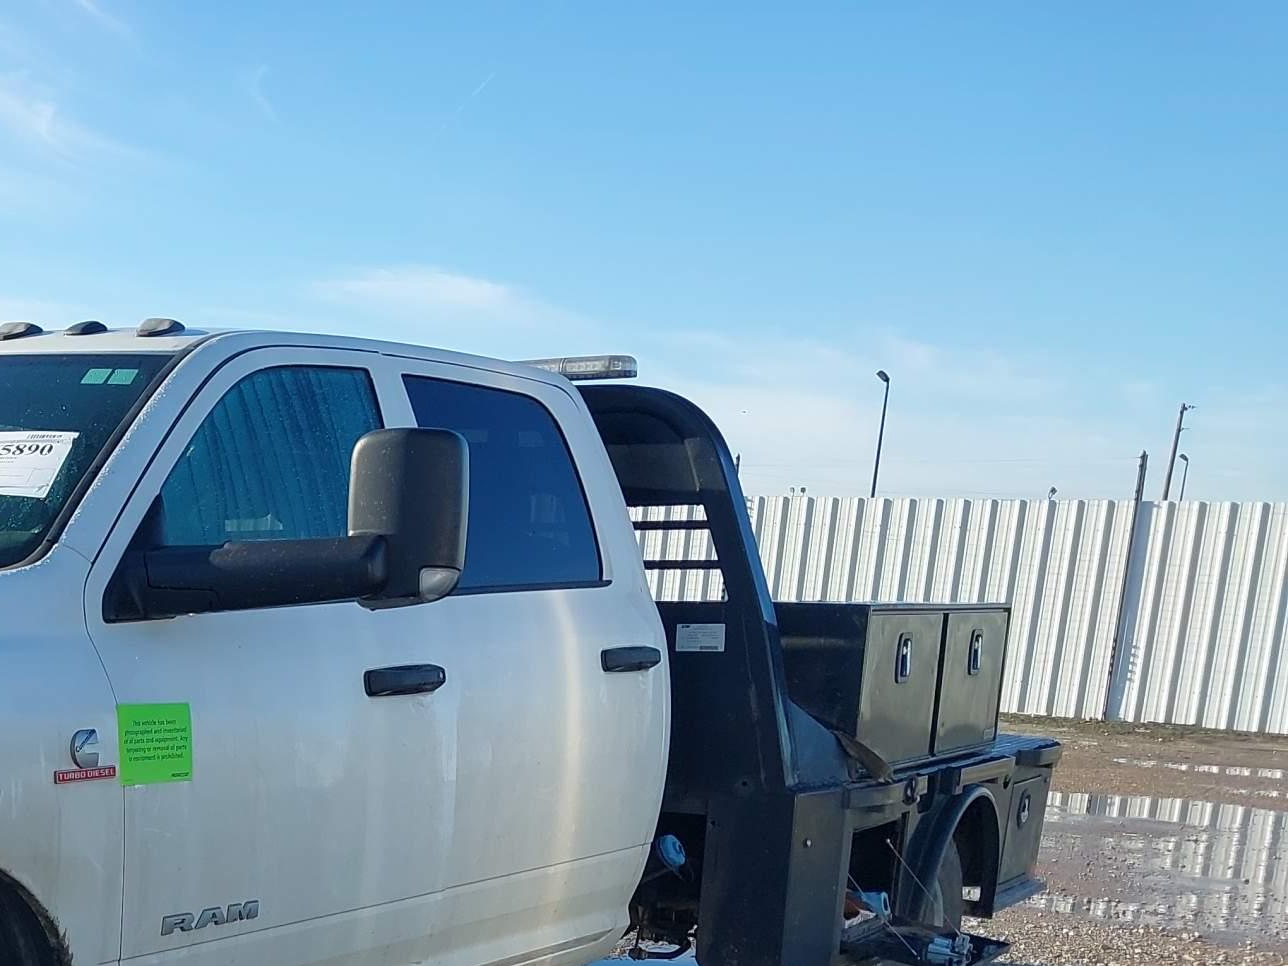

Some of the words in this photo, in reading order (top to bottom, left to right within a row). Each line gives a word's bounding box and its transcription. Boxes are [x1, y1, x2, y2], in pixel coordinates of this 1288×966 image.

[59, 771, 86, 780] TURBO
[87, 767, 115, 777] DIESEL
[161, 899, 260, 936] RAM
